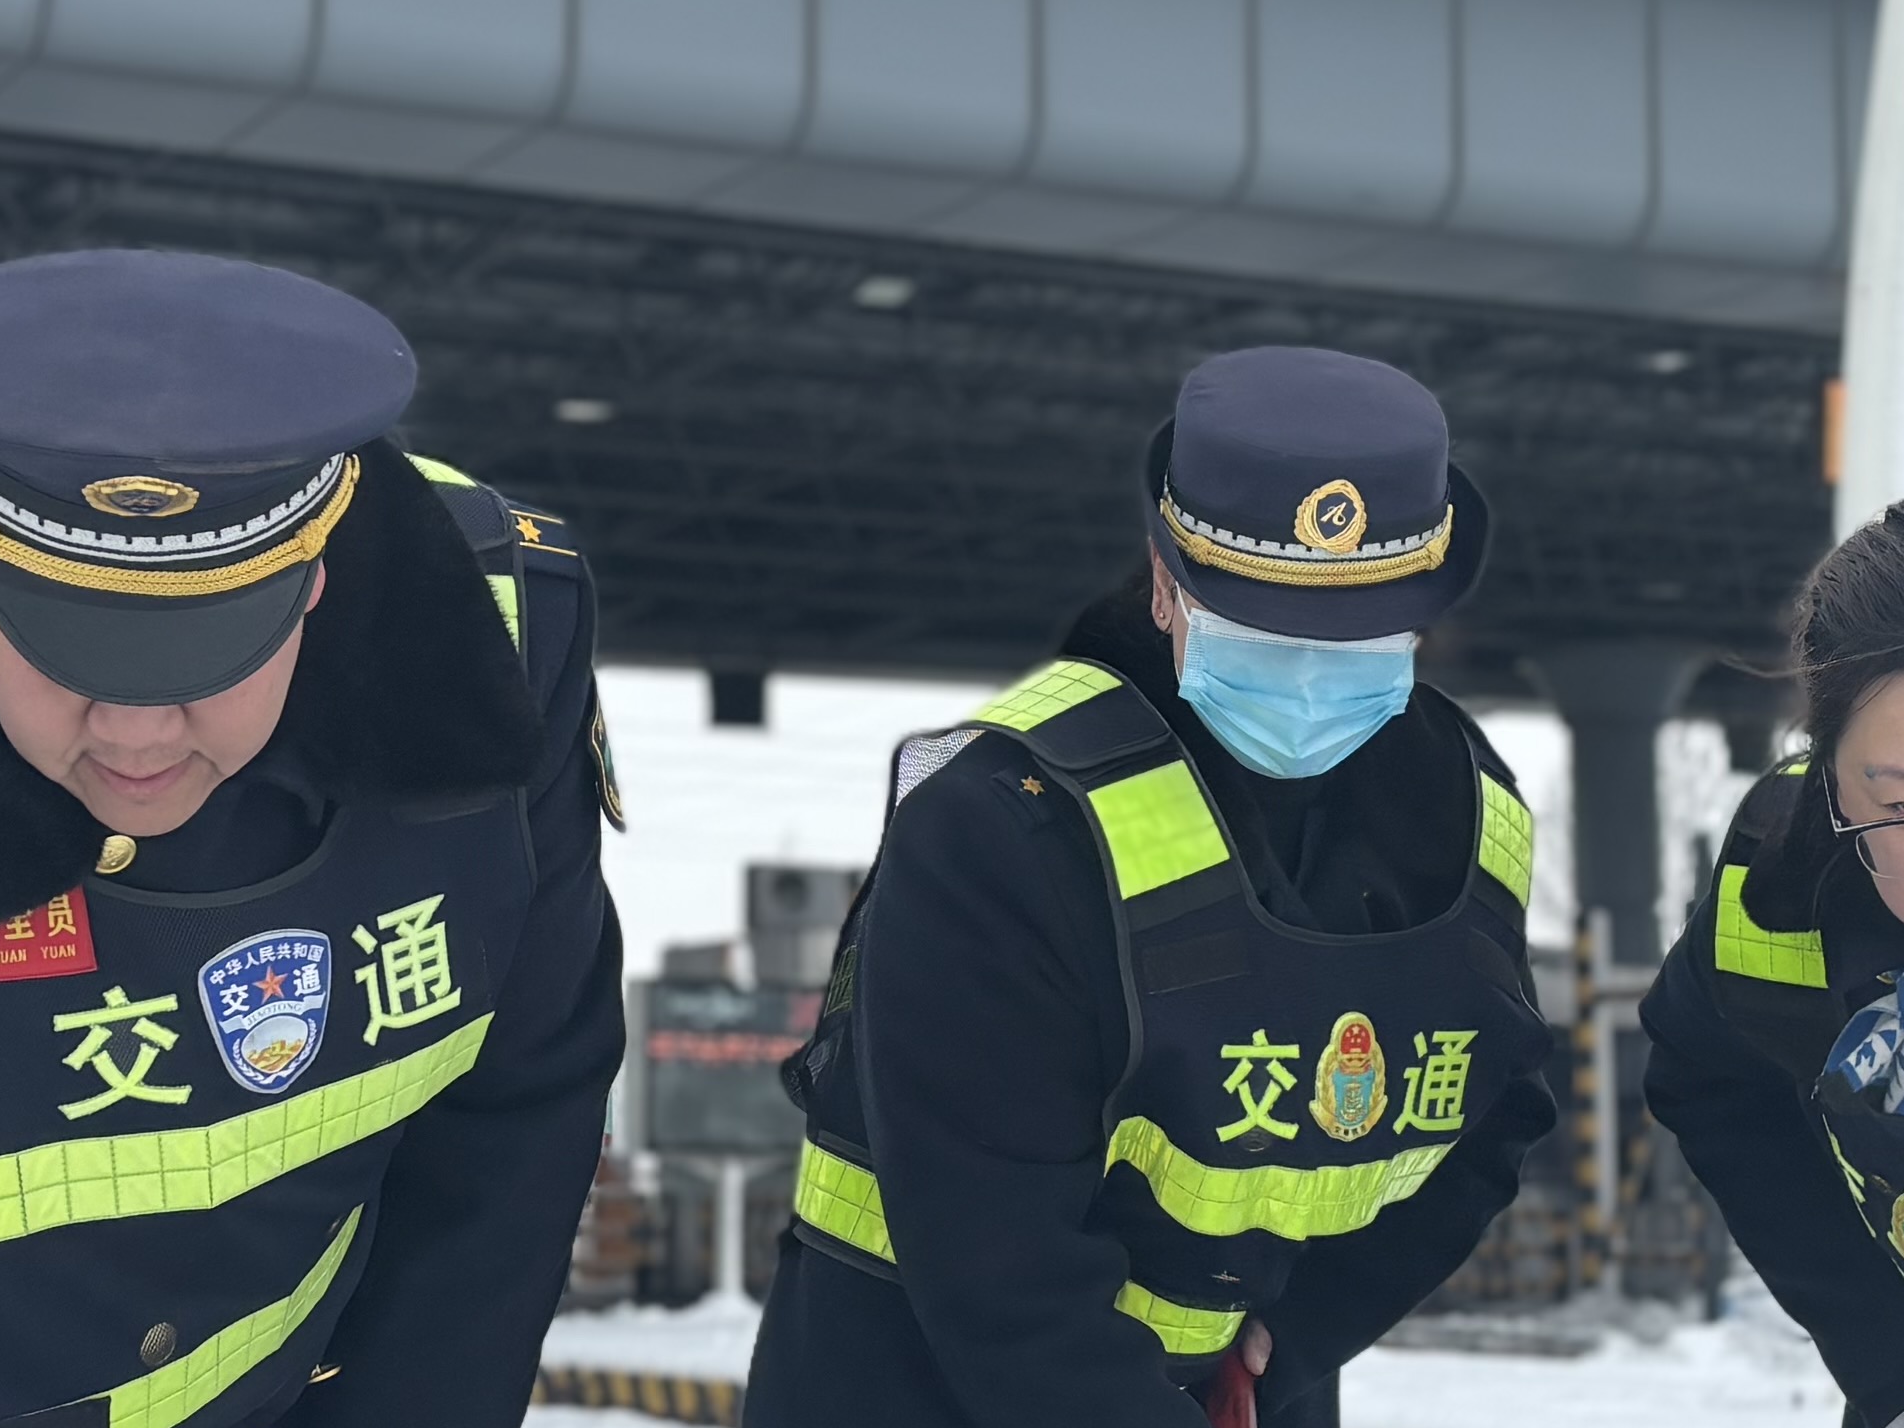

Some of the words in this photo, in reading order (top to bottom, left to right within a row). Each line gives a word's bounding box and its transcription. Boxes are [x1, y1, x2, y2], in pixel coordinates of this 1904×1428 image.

[40, 943, 76, 960] YUAN
[209, 942, 325, 986] 中华人民共和国
[52, 894, 462, 1122] 交通
[218, 963, 323, 1017] 交通
[1215, 1028, 1479, 1143] 交通
